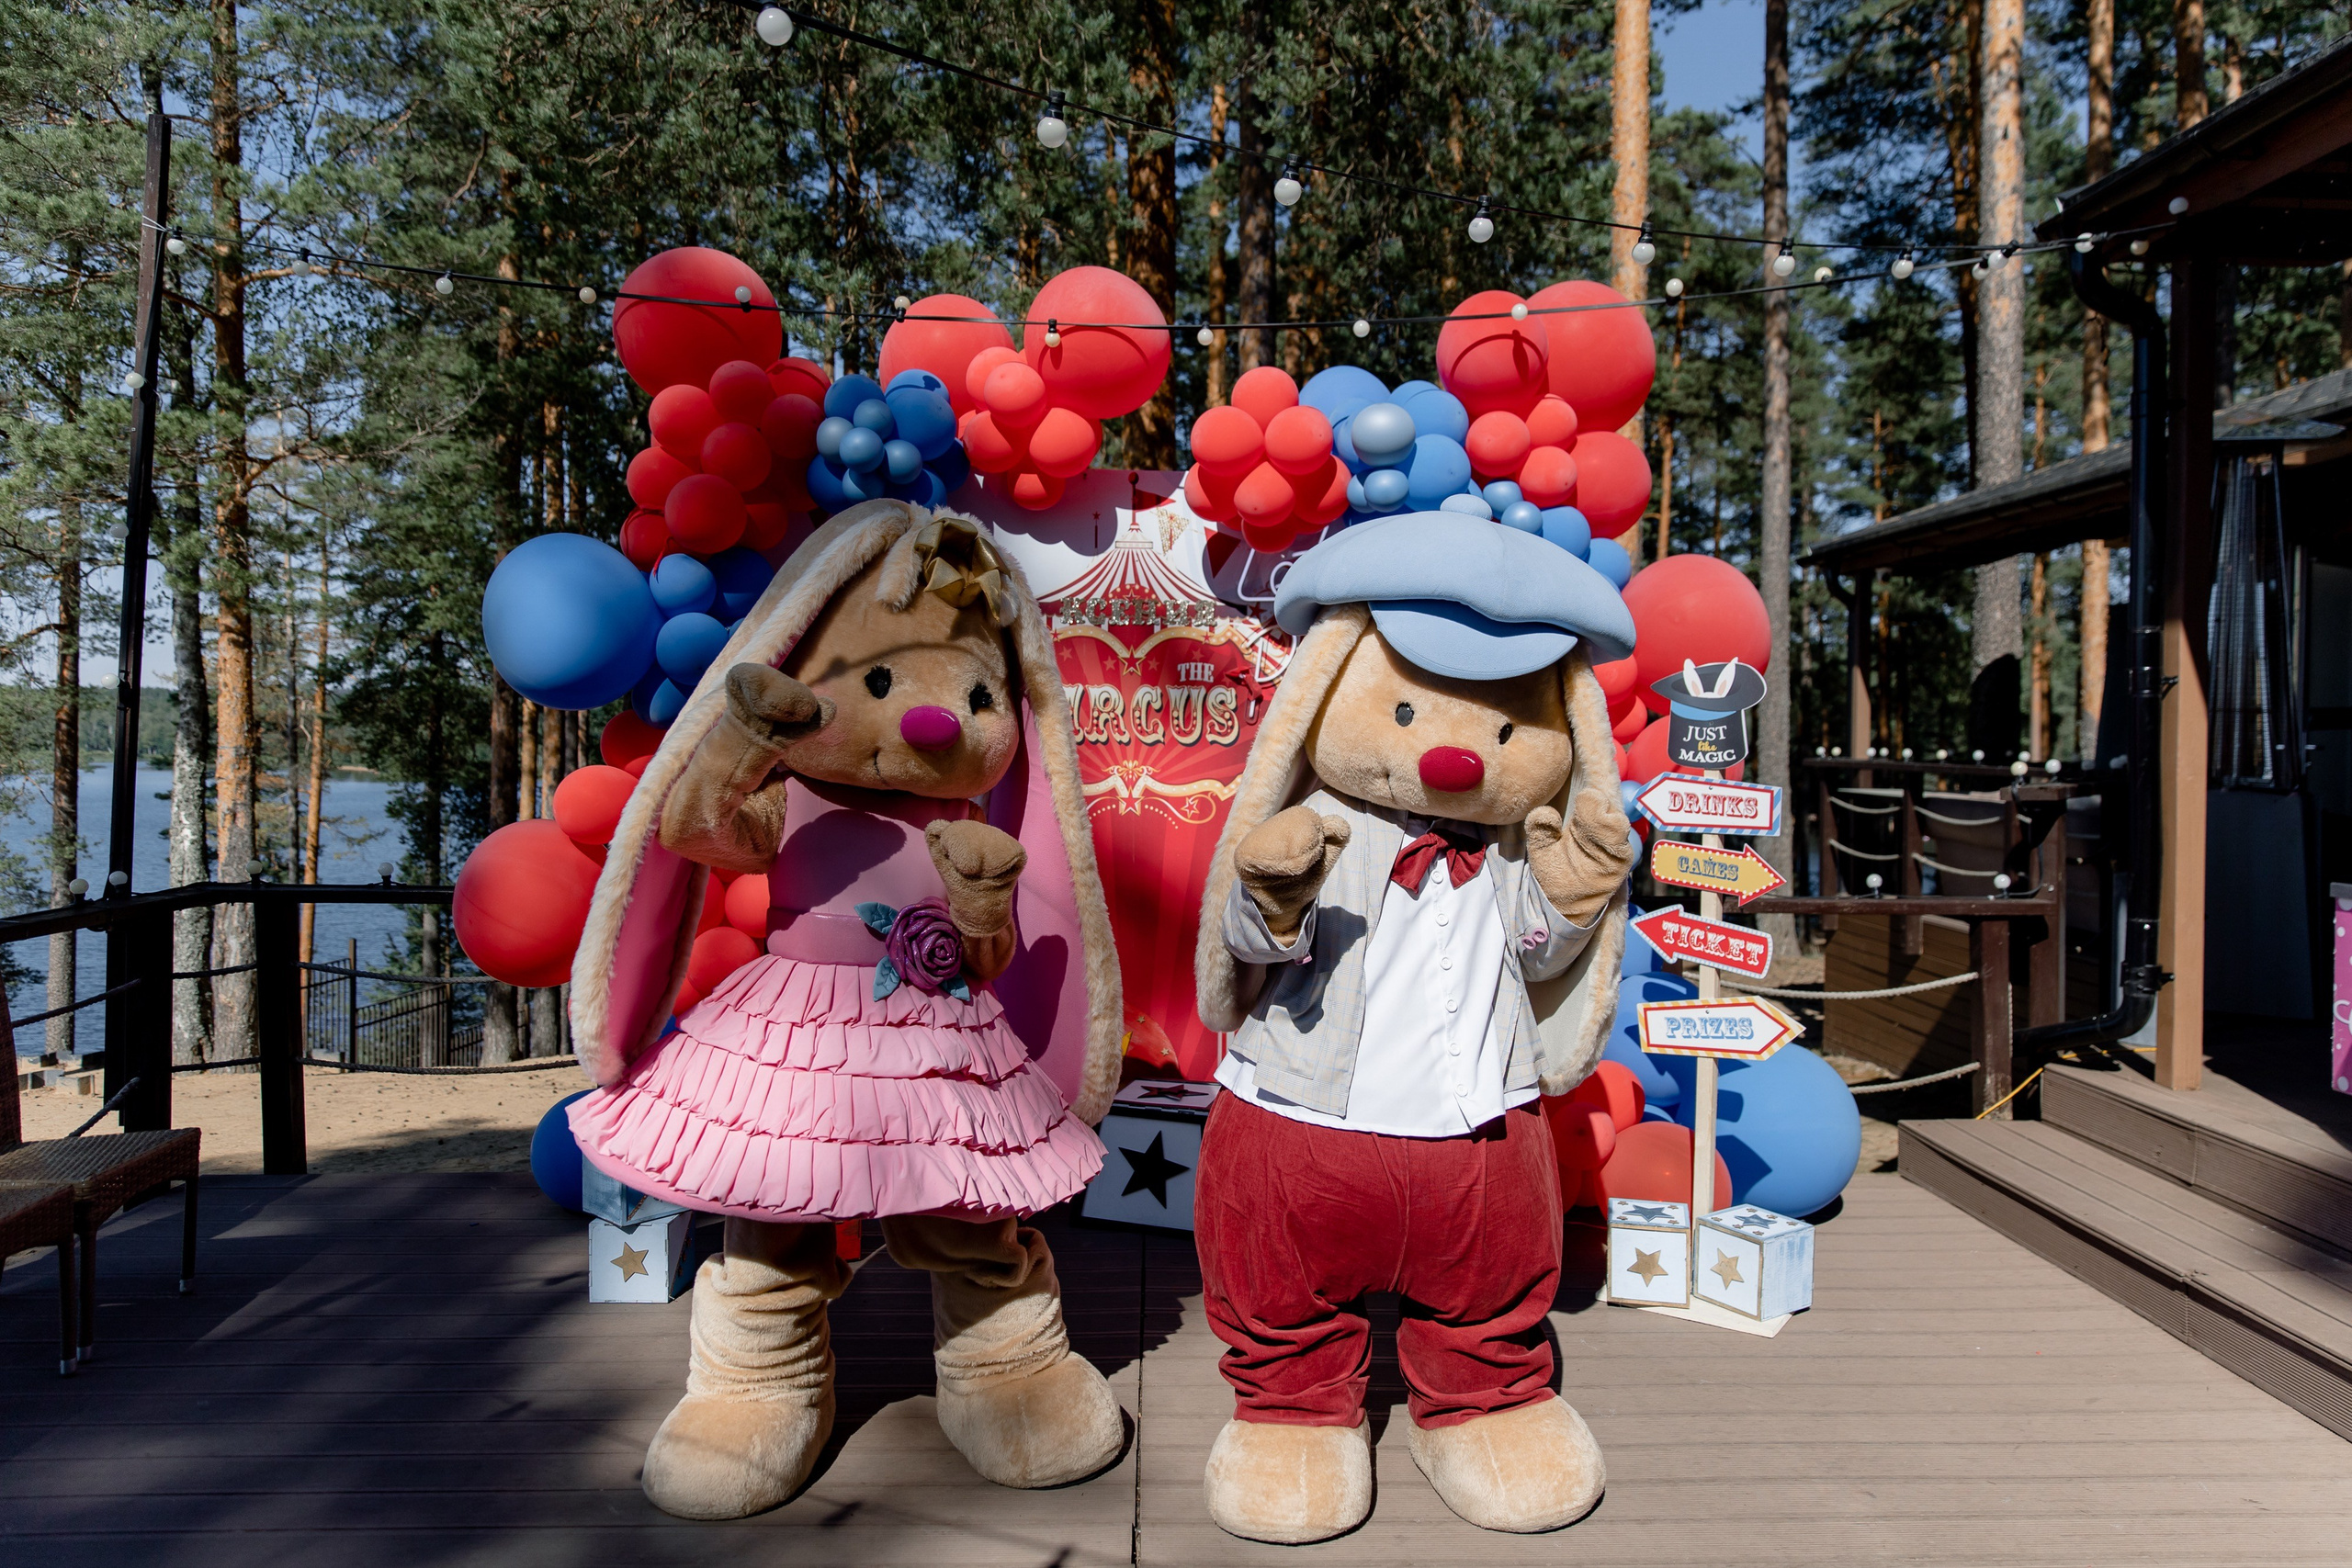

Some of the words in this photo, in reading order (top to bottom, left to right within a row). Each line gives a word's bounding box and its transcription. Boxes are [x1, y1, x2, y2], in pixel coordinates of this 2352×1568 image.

[1059, 597, 1218, 626] КСЕНИЯ
[1177, 661, 1215, 683] THE
[1062, 682, 1241, 747] IRCUS
[1682, 725, 1727, 742] JUST
[1698, 740, 1717, 751] like
[1679, 748, 1736, 763] MAGIC
[1668, 790, 1758, 818] DRINKS
[1677, 855, 1739, 882] GAMES
[1661, 920, 1764, 966] TICKET
[1664, 1016, 1754, 1040] PRIZES
